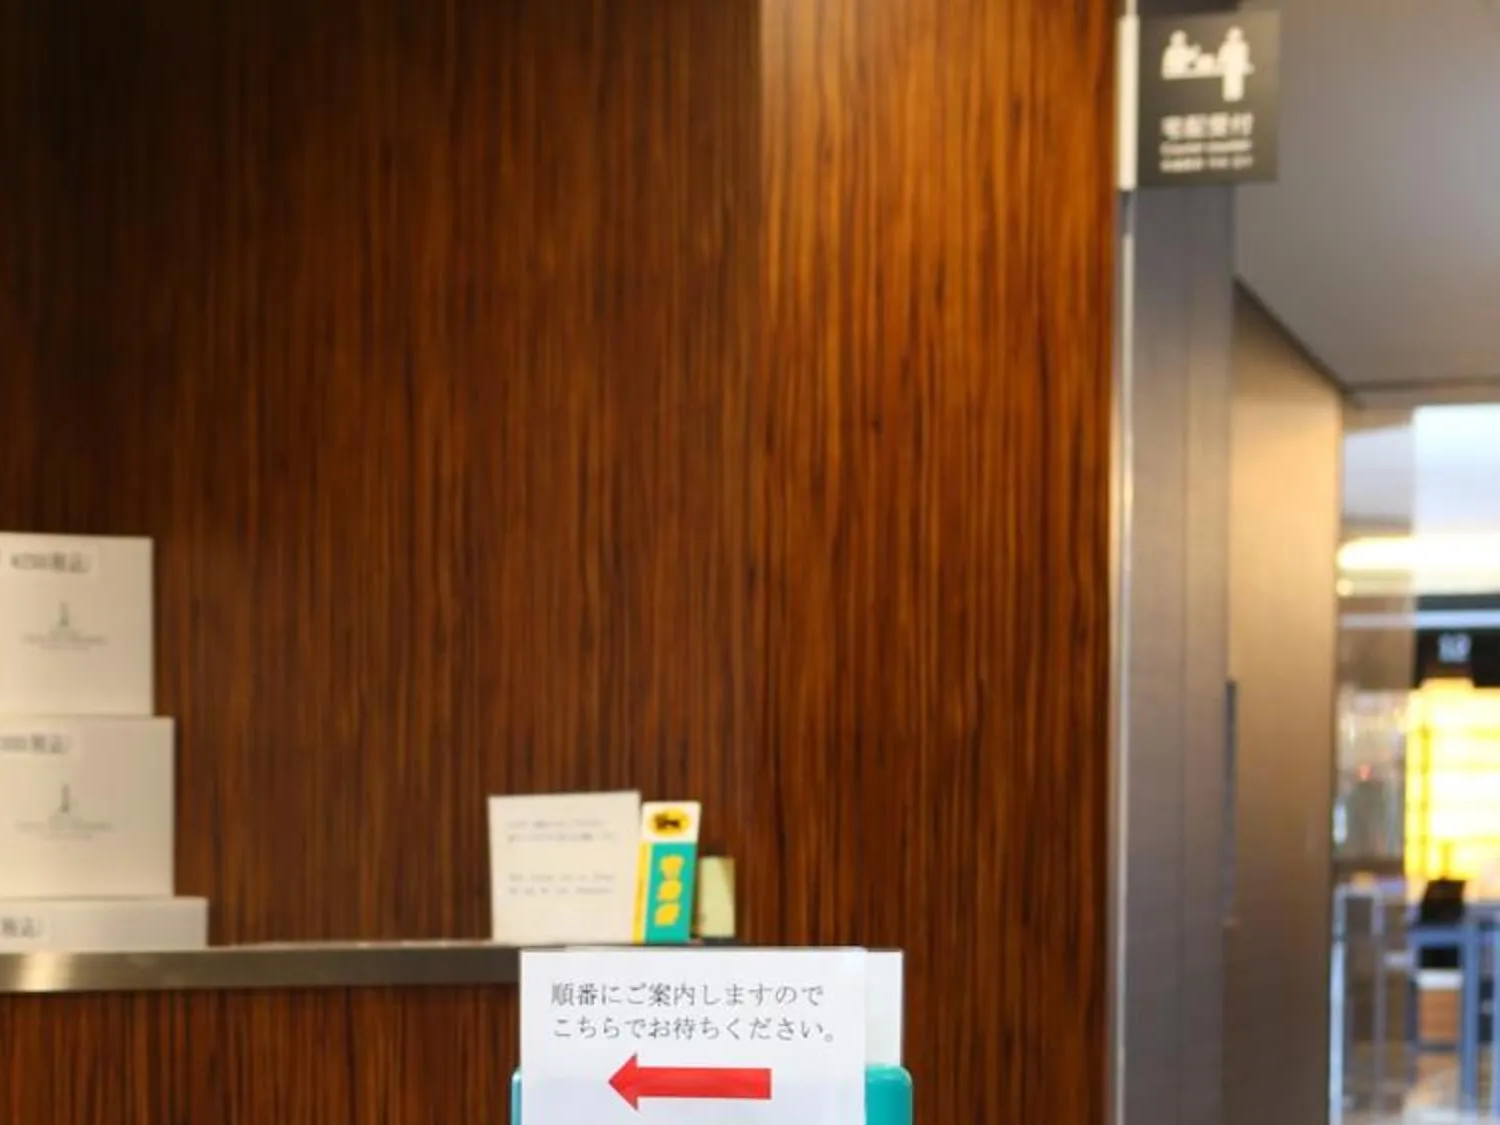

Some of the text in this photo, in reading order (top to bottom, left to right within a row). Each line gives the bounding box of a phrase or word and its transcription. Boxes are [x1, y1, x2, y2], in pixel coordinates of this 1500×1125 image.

[550, 982, 825, 1007] 順番にご案内しますので
[552, 1015, 834, 1043] こちらでお待ちください。
